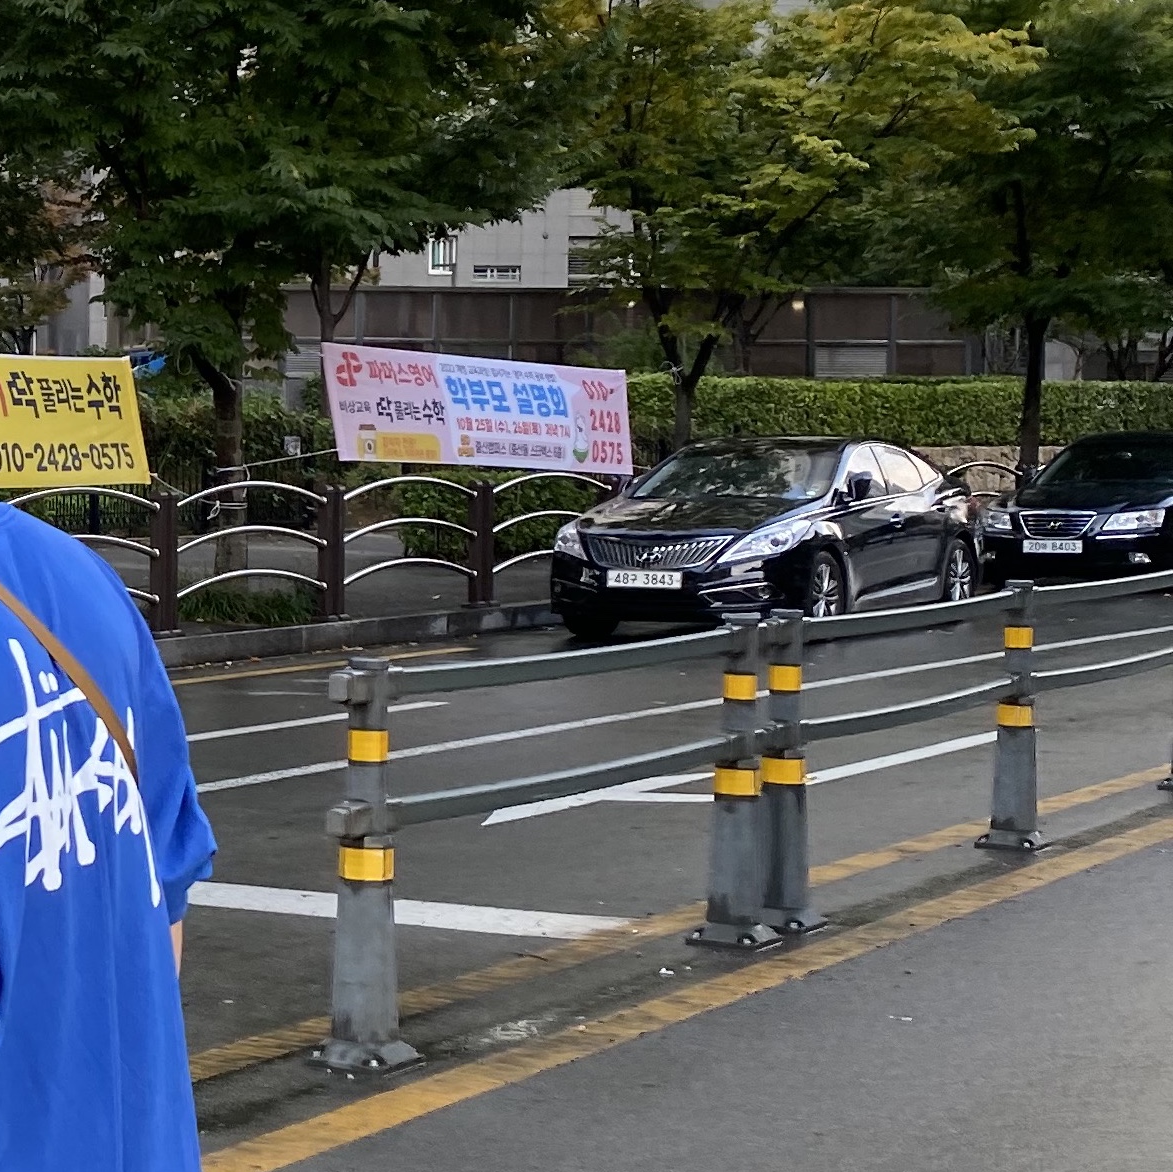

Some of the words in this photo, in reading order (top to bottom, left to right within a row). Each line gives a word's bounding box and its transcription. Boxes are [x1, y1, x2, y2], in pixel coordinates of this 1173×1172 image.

[444, 375, 510, 414] 학부모
[513, 382, 570, 419] 설명회
[590, 408, 621, 435] 2428
[592, 440, 624, 465] 0575
[643, 573, 674, 586] 3843
